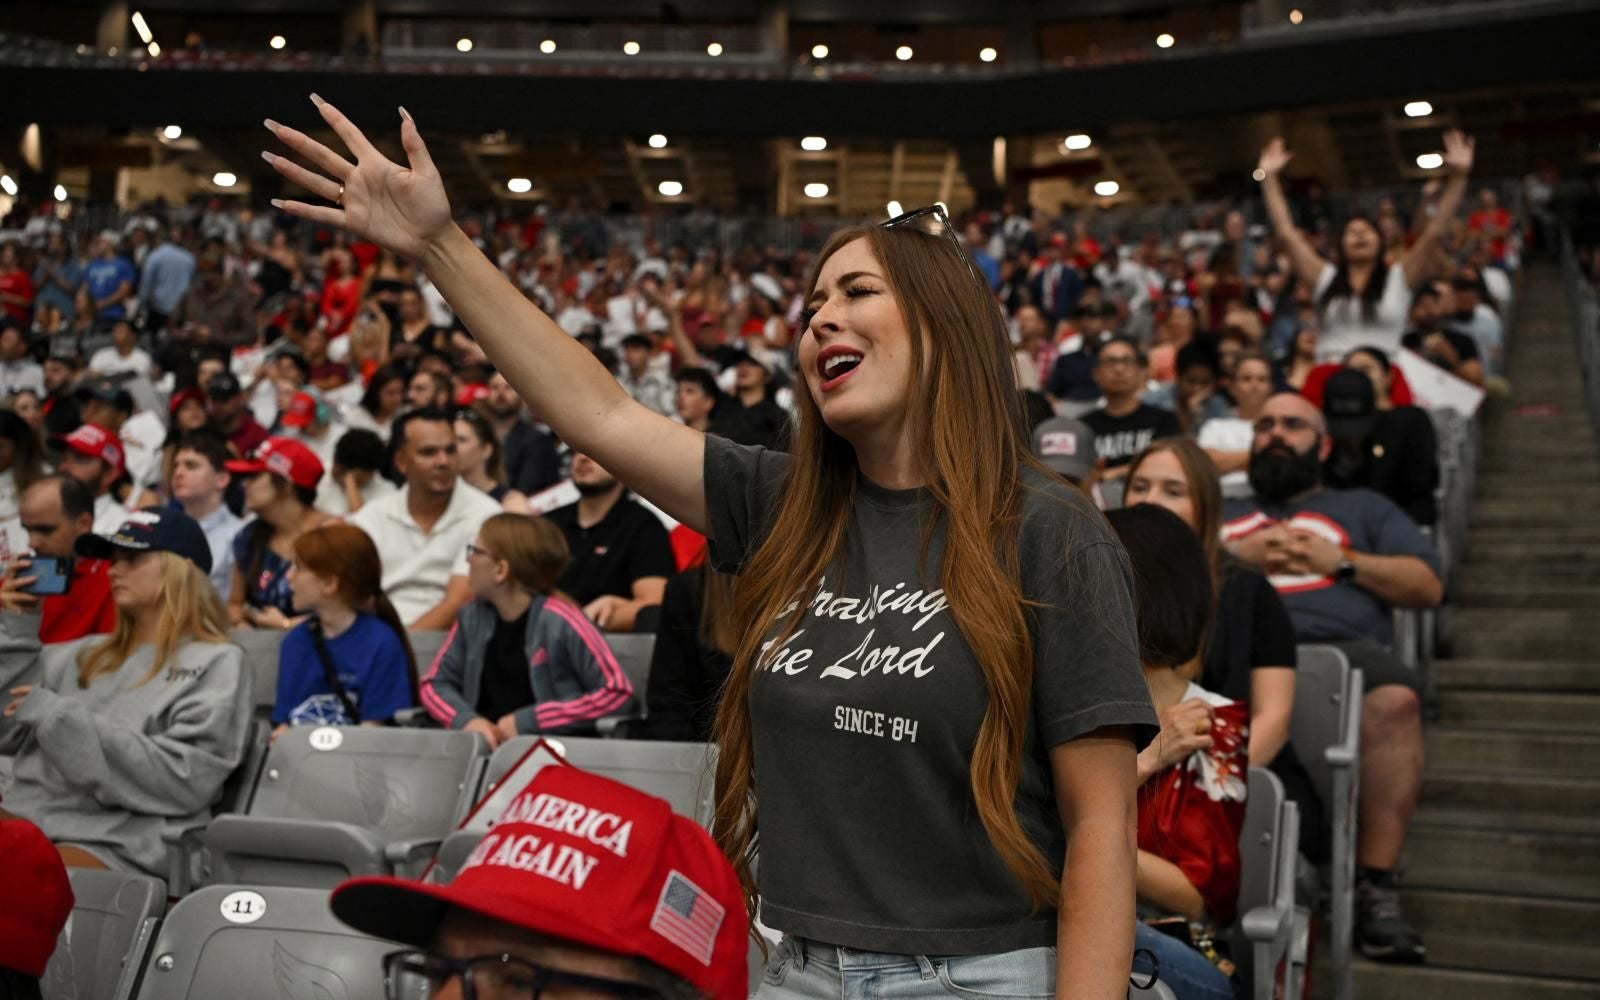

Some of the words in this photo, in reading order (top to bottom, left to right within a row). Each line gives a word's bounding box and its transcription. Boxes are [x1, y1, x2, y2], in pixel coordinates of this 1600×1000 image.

[774, 575, 950, 632] raiing
[820, 627, 945, 680] Lord
[834, 705, 885, 737] SINCE
[887, 716, 919, 743] '84
[501, 792, 633, 858] AMERICA
[487, 834, 599, 891] AGAIN
[231, 899, 253, 915] 11
